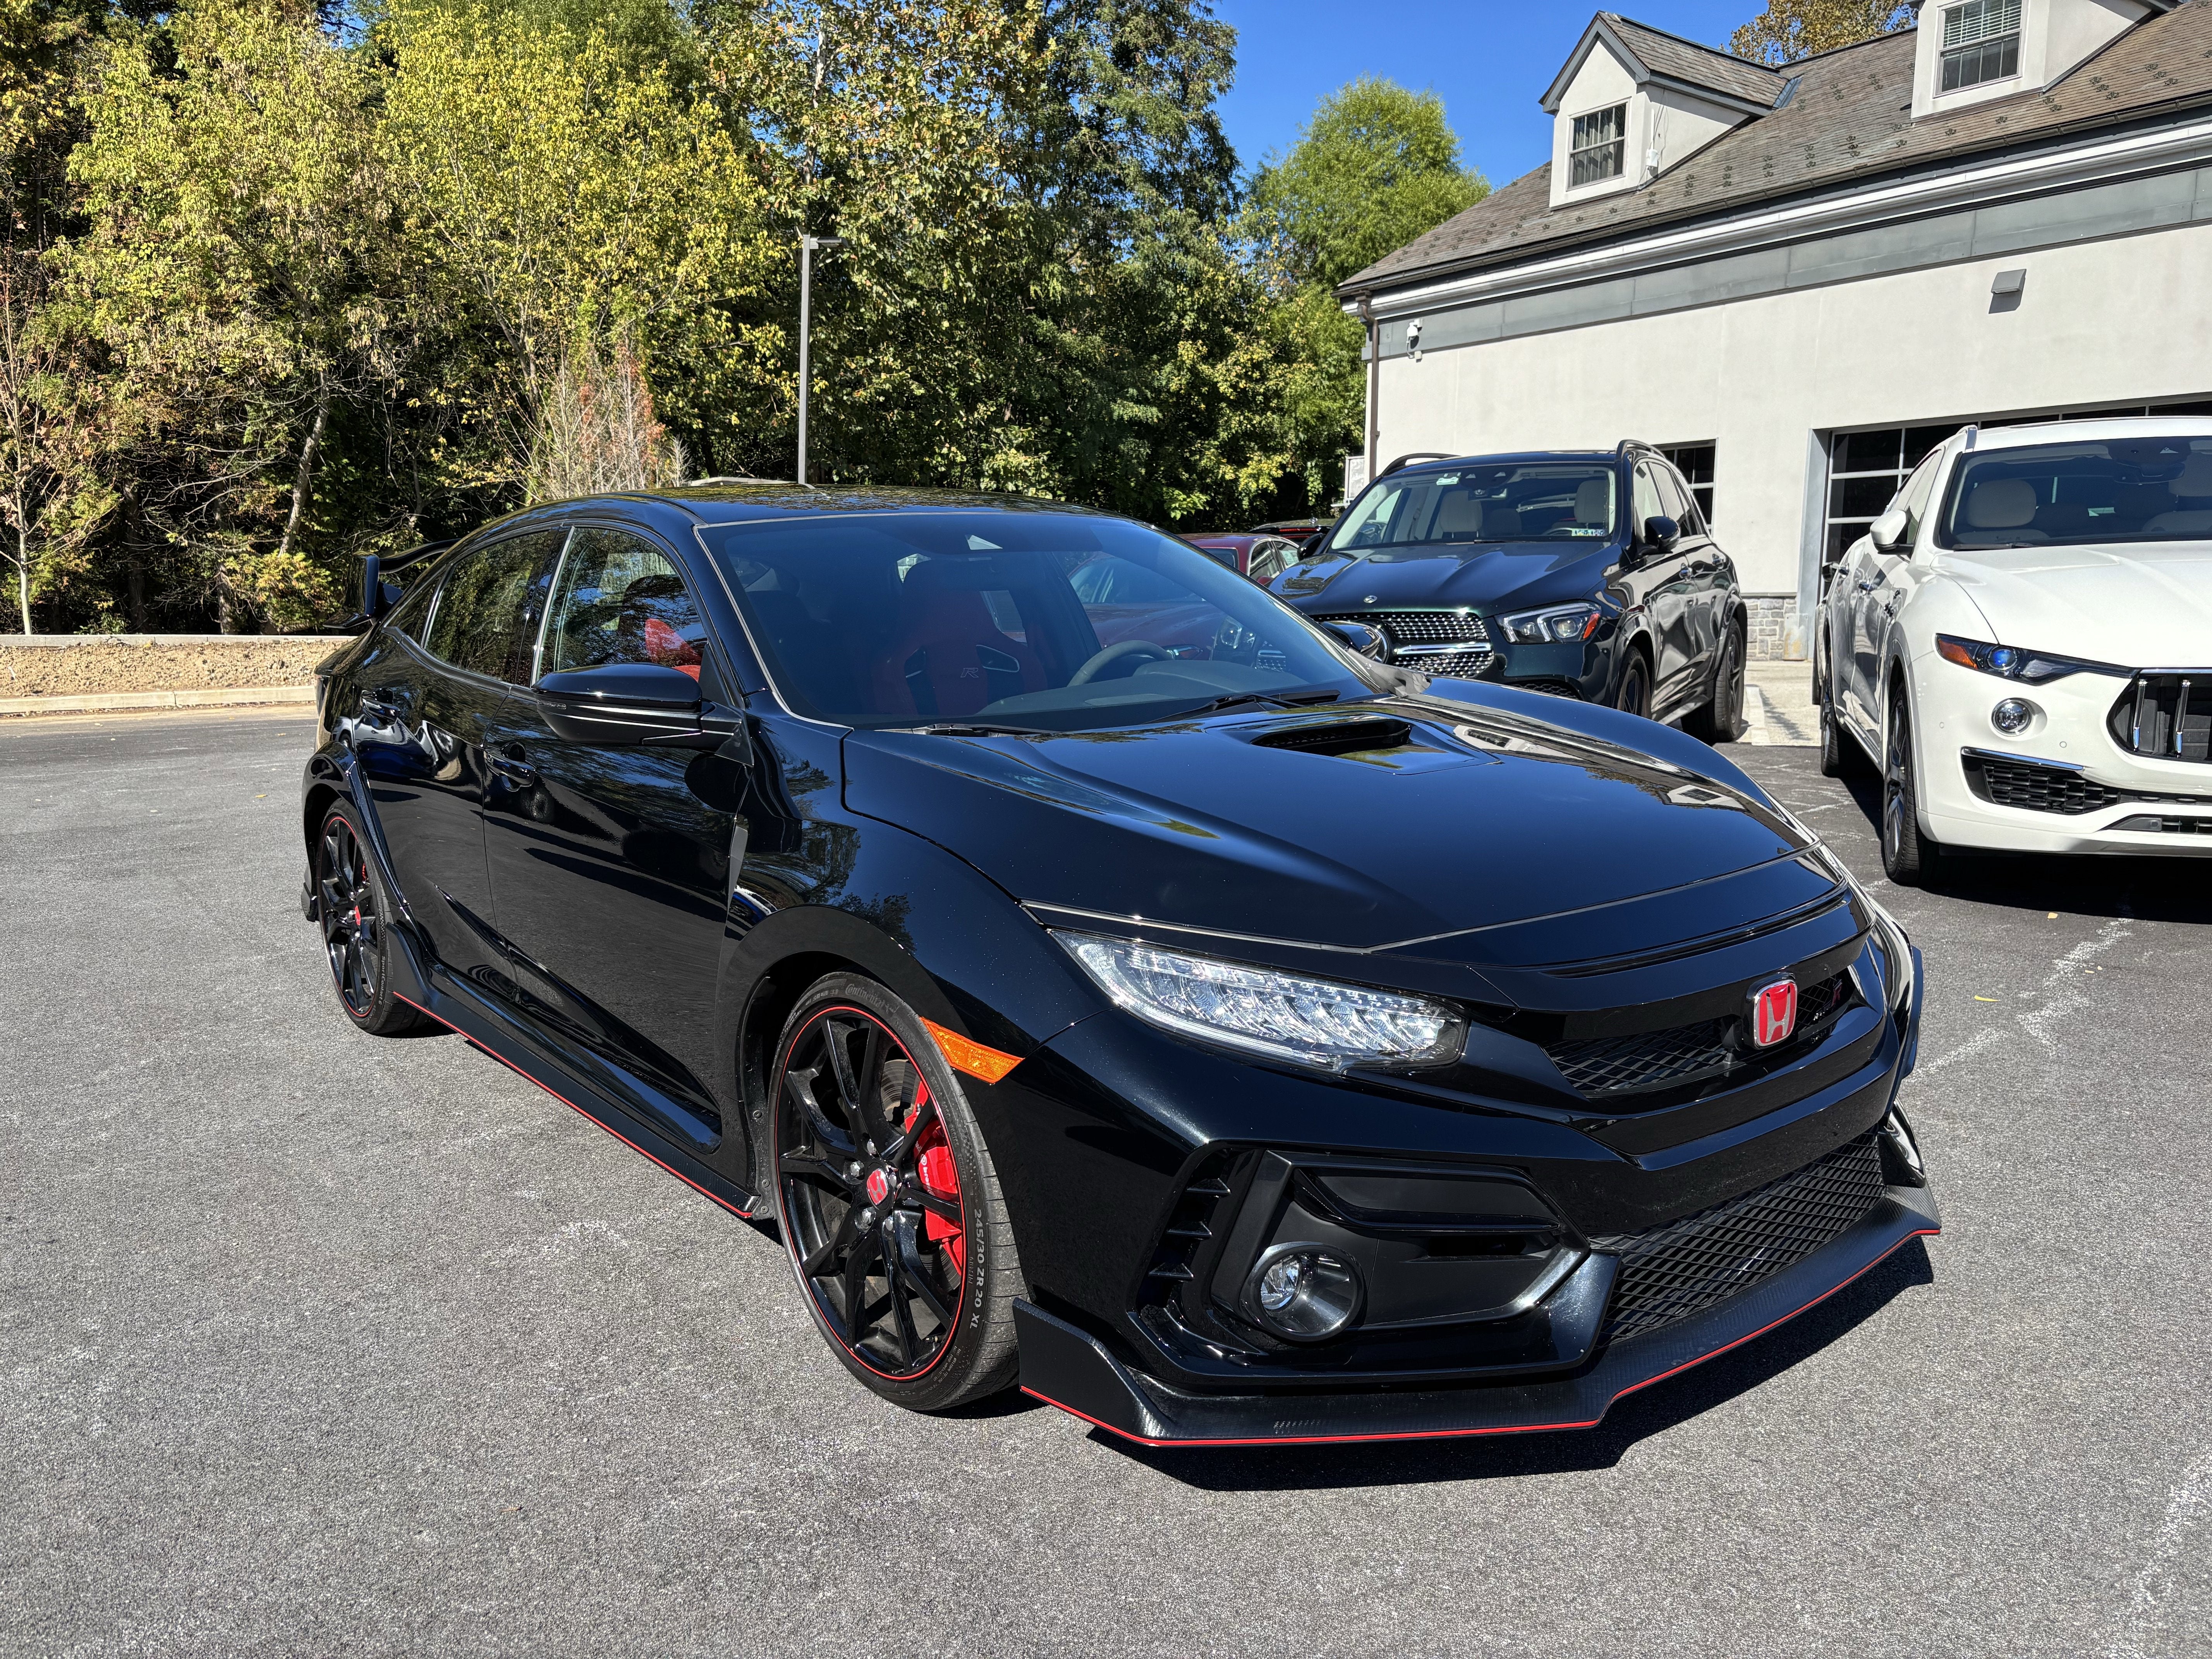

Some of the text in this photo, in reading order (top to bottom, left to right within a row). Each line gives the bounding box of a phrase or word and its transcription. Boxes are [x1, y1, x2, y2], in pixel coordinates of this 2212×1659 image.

[960, 668, 979, 678] R
[970, 1209, 985, 1329] 245/30 ZR 20 XL
